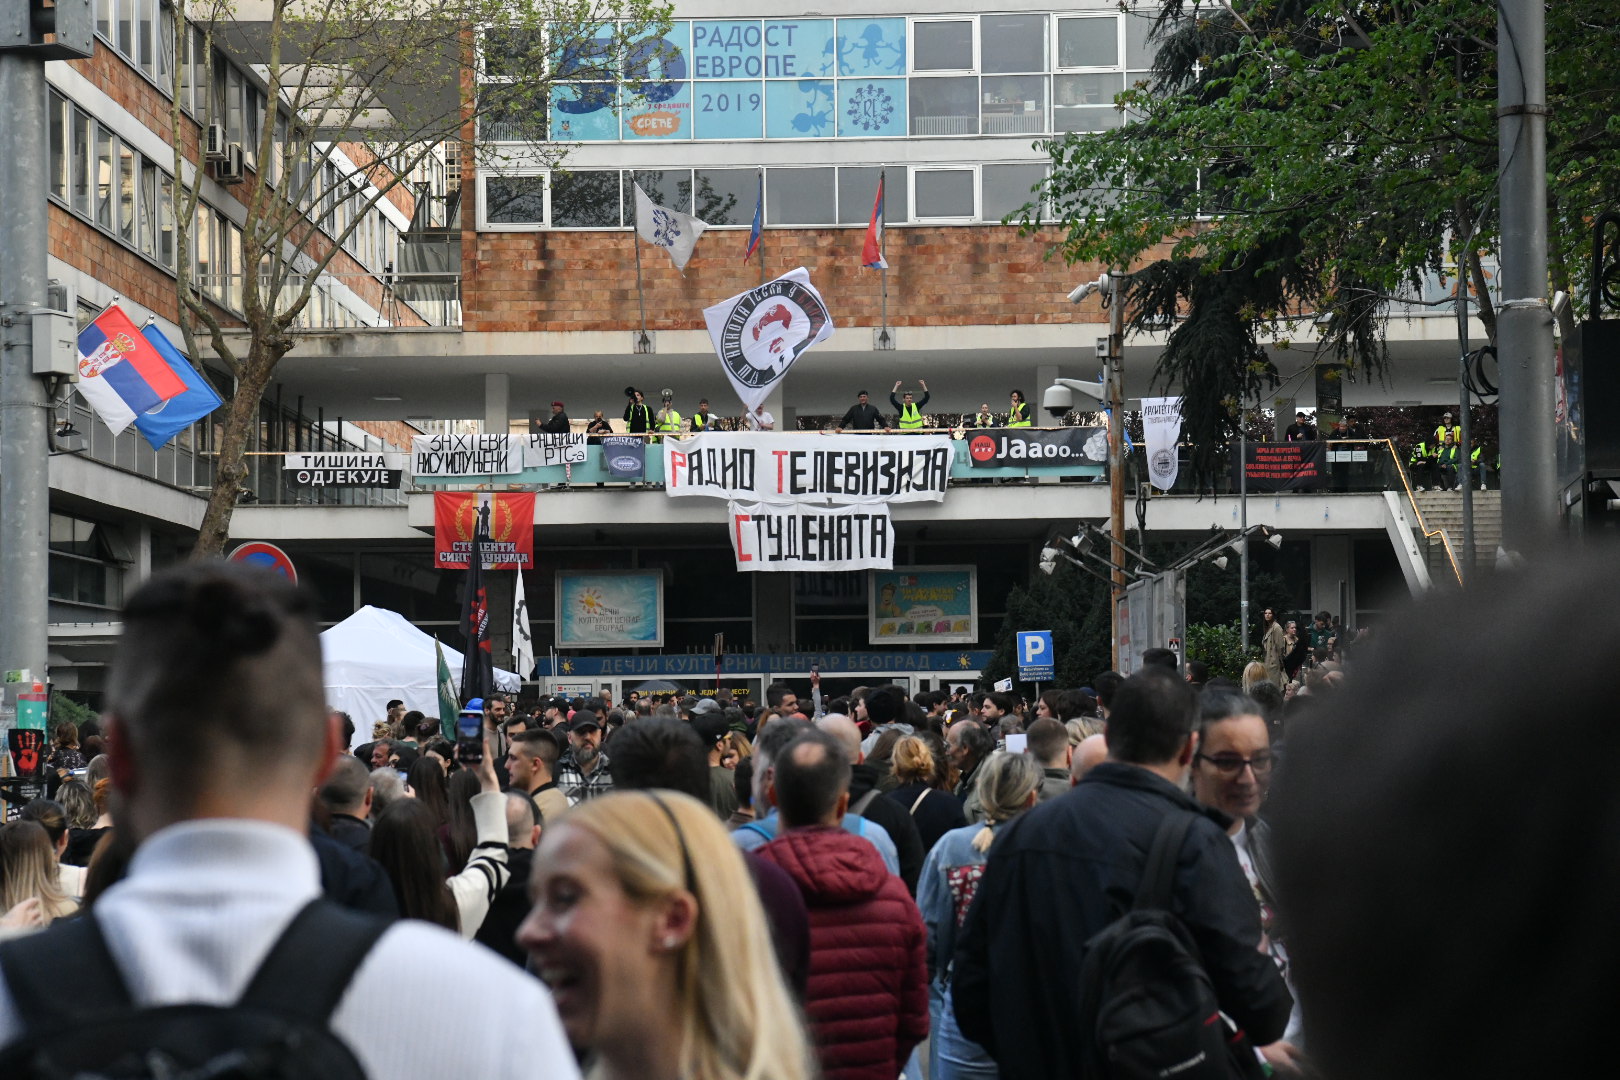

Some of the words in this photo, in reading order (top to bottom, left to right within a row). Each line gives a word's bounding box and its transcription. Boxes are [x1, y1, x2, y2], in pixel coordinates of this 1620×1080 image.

[693, 25, 798, 51] РАДОСТ
[693, 56, 797, 77] ЕВРОПЕ
[701, 93, 760, 111] 2019
[636, 117, 673, 129] СРЕЋЕ
[302, 455, 386, 468] ТИШИНА
[416, 451, 445, 474] НИСУ
[445, 450, 509, 474] ИСПУЊЕНИ
[671, 448, 756, 491] РАДИО
[772, 448, 948, 496] ТЕЛЕВИЗИЈА
[296, 470, 390, 487] ОДЈЕКУЈЕ
[734, 514, 888, 562] СТУДЕНАТА
[1025, 635, 1044, 662] P
[600, 658, 658, 674] ДЕЧЈИ
[664, 656, 761, 672] КУЛТРНИ
[768, 654, 840, 671] ЦЕНТАР
[846, 652, 931, 671] БЕОГРАД
